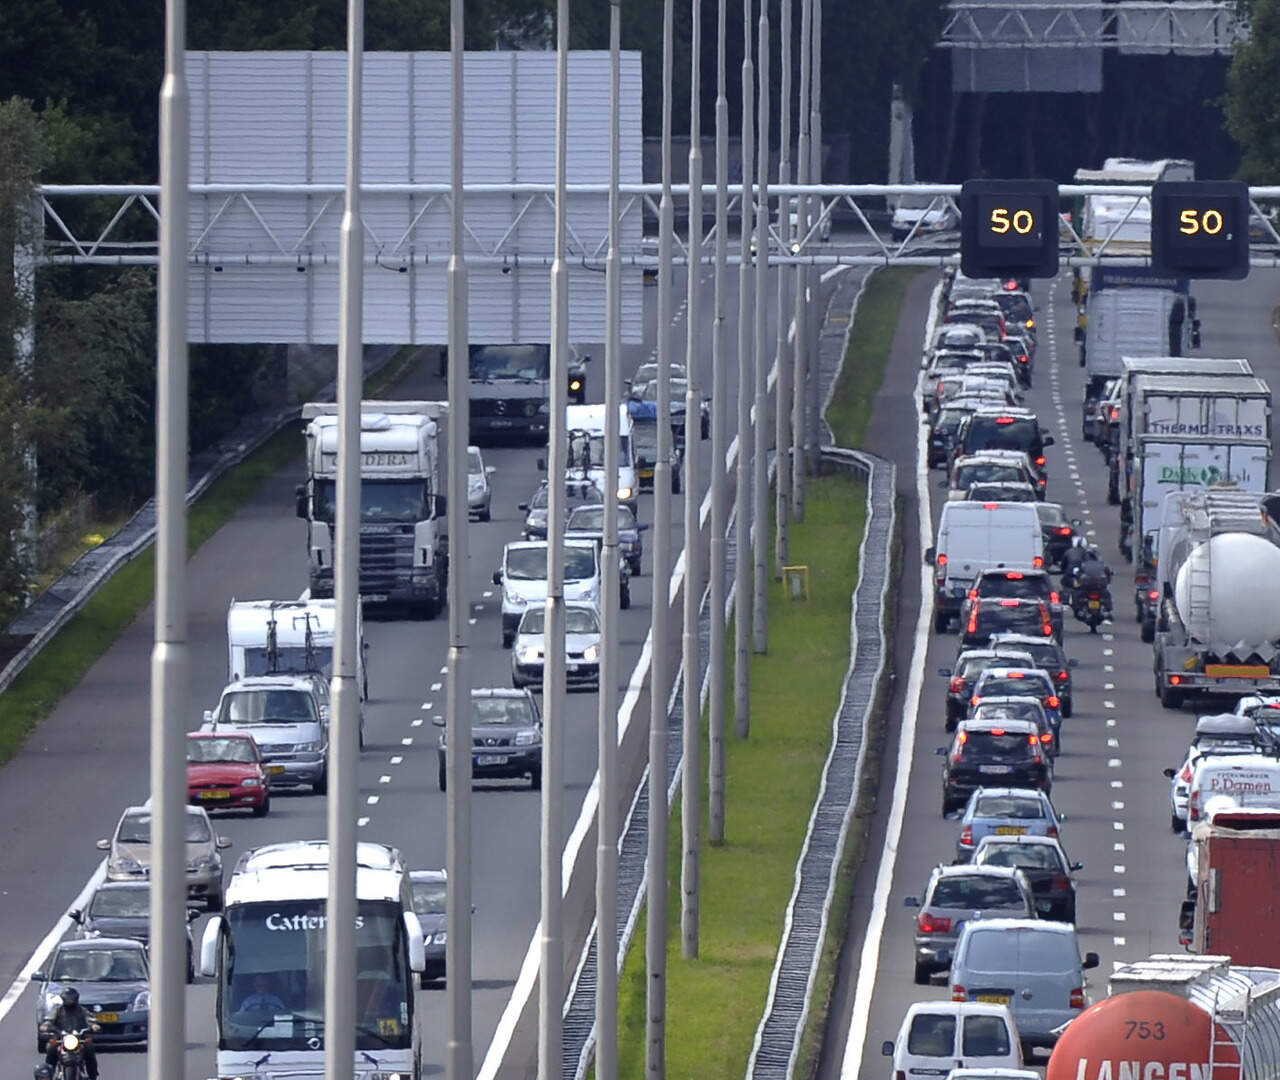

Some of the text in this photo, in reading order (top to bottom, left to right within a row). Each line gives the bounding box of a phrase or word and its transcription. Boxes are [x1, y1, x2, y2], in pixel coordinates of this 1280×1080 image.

[990, 208, 1034, 235] 50
[1179, 209, 1223, 235] 50
[1125, 1021, 1167, 1041] 753
